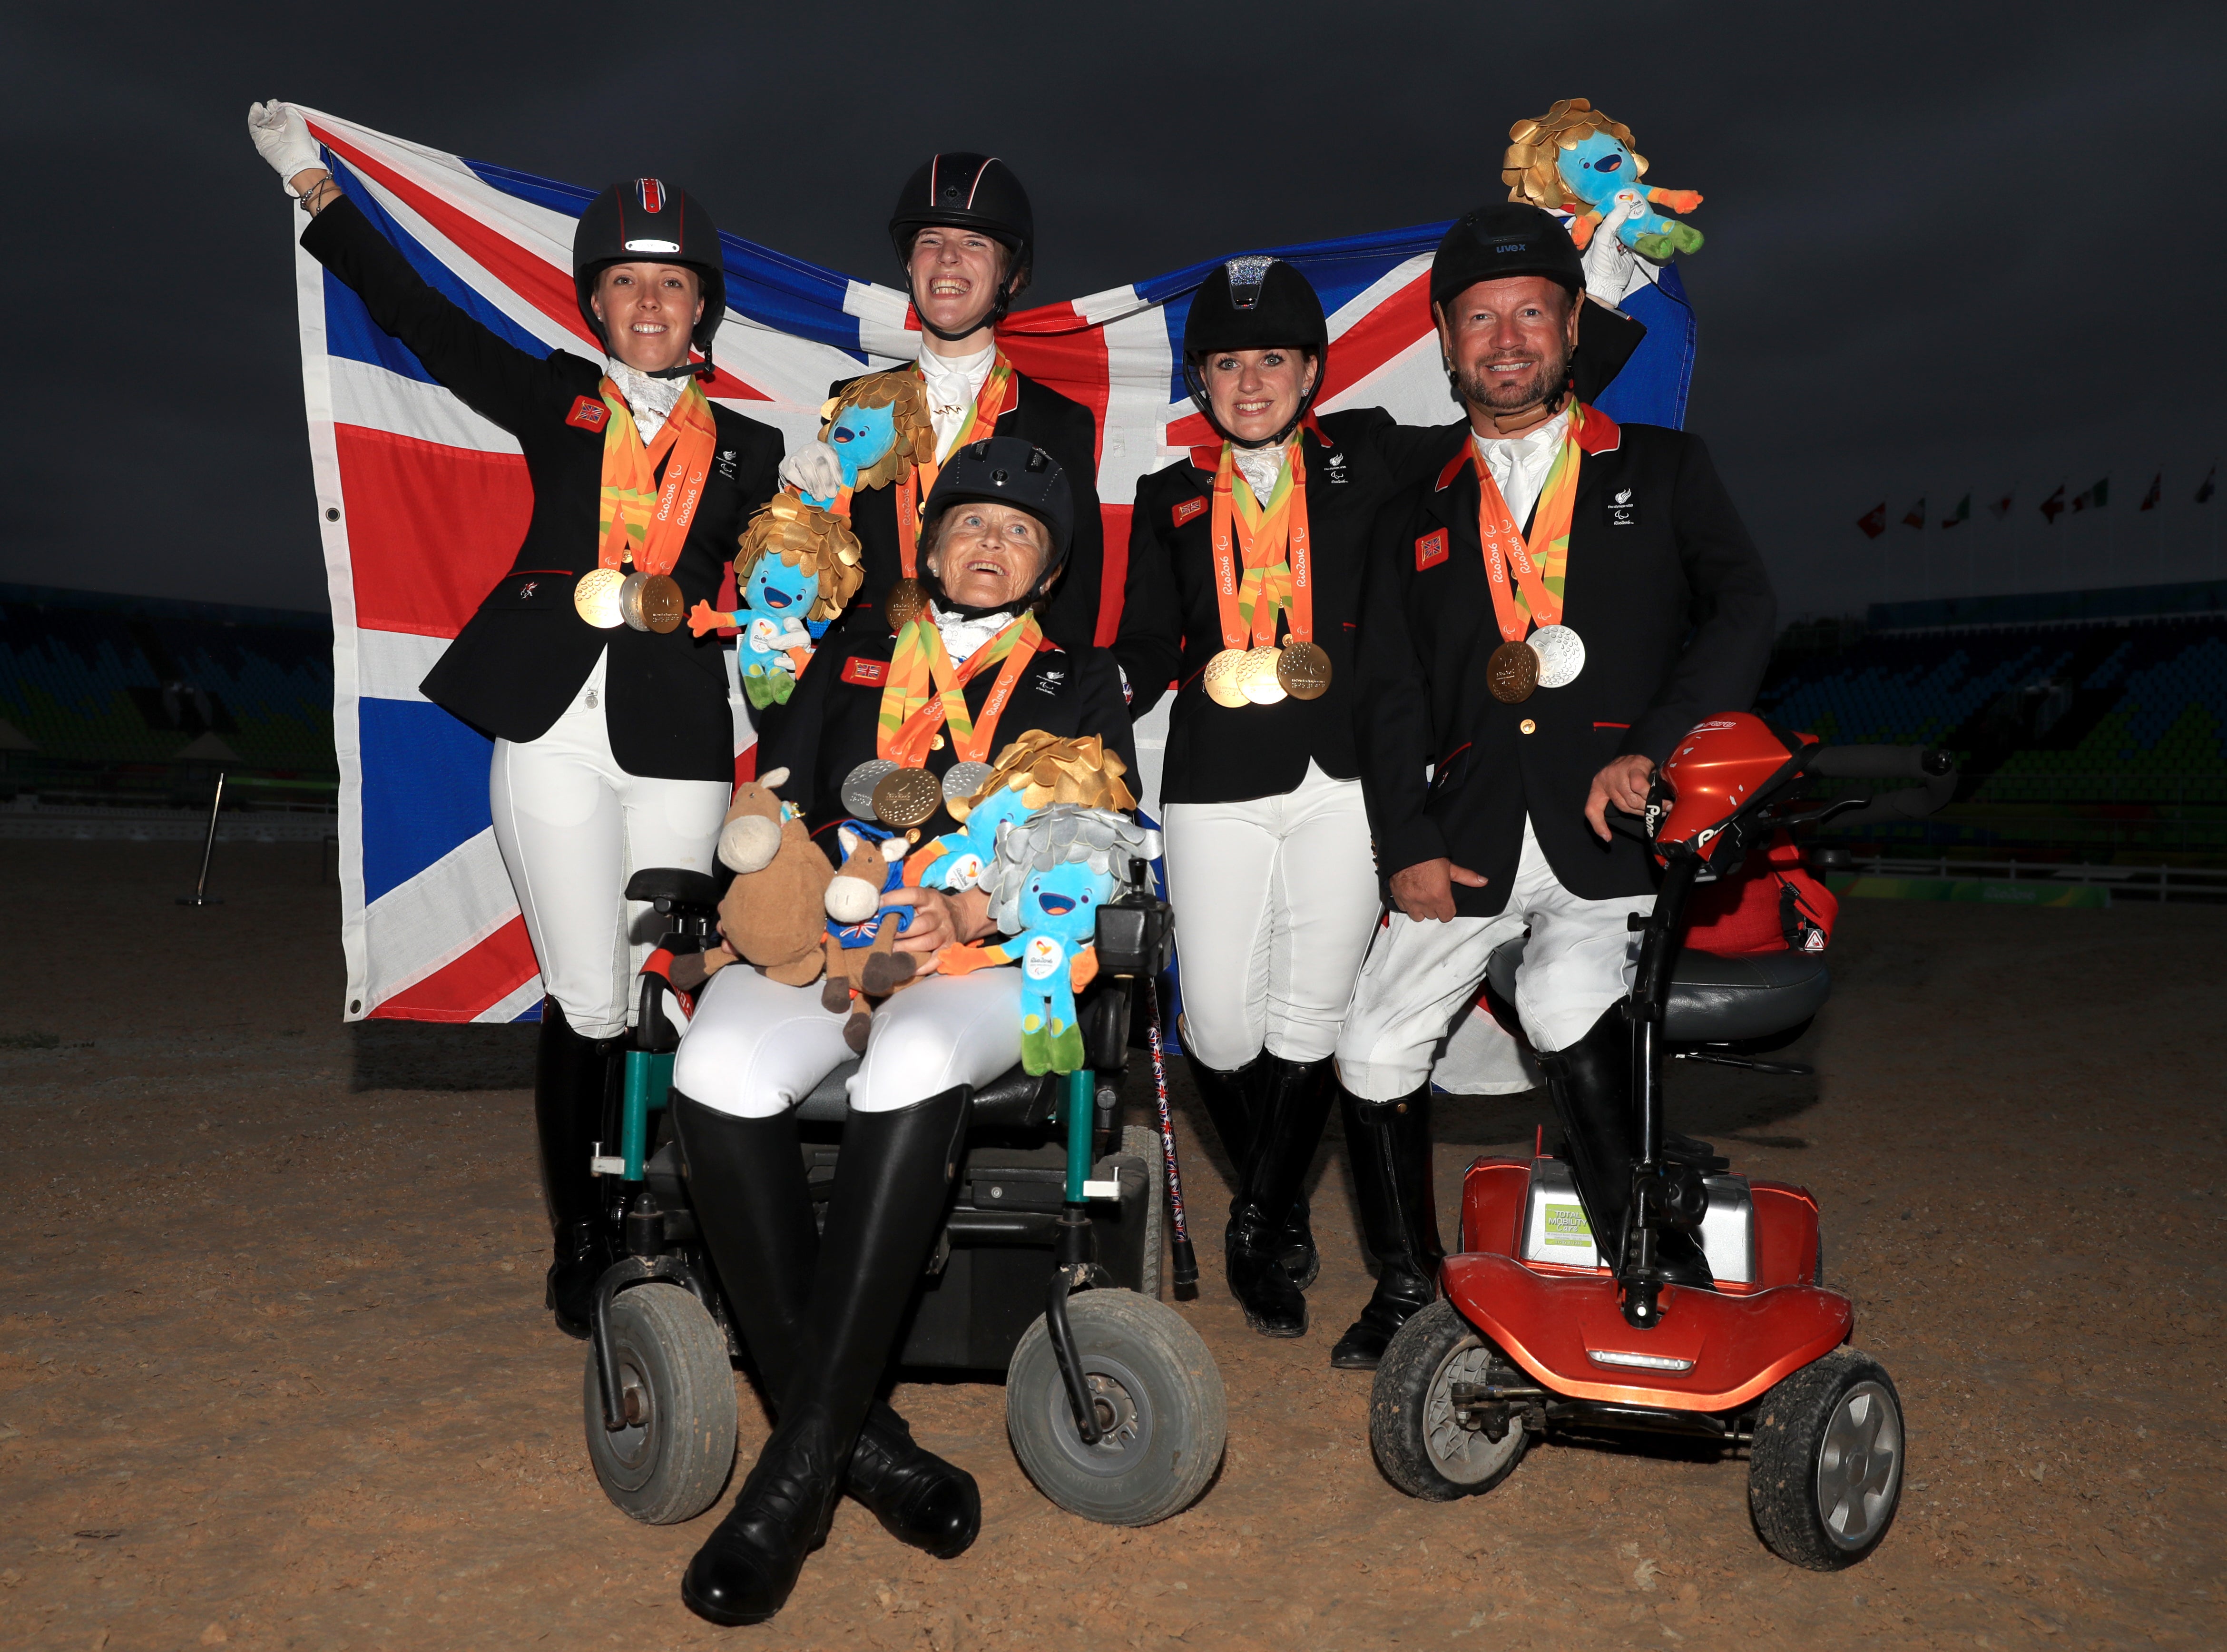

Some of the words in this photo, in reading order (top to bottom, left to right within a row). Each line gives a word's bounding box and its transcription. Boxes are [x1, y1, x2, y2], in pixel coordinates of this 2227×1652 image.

[1496, 244, 1526, 253] uvex
[657, 483, 676, 521] Rio2016
[677, 489, 697, 526] Rio2016
[902, 488, 911, 526] Rio2016
[1295, 548, 1306, 587] Rio2016
[1488, 543, 1504, 583] Rio2016
[1507, 537, 1531, 573] Rio2016
[1219, 556, 1233, 595] Rio2016
[986, 688, 1007, 716] Rio2016
[1549, 1217, 1588, 1227] MOBILITY
[1555, 1210, 1582, 1219] TOTAL
[1556, 1223, 1578, 1232] Care
